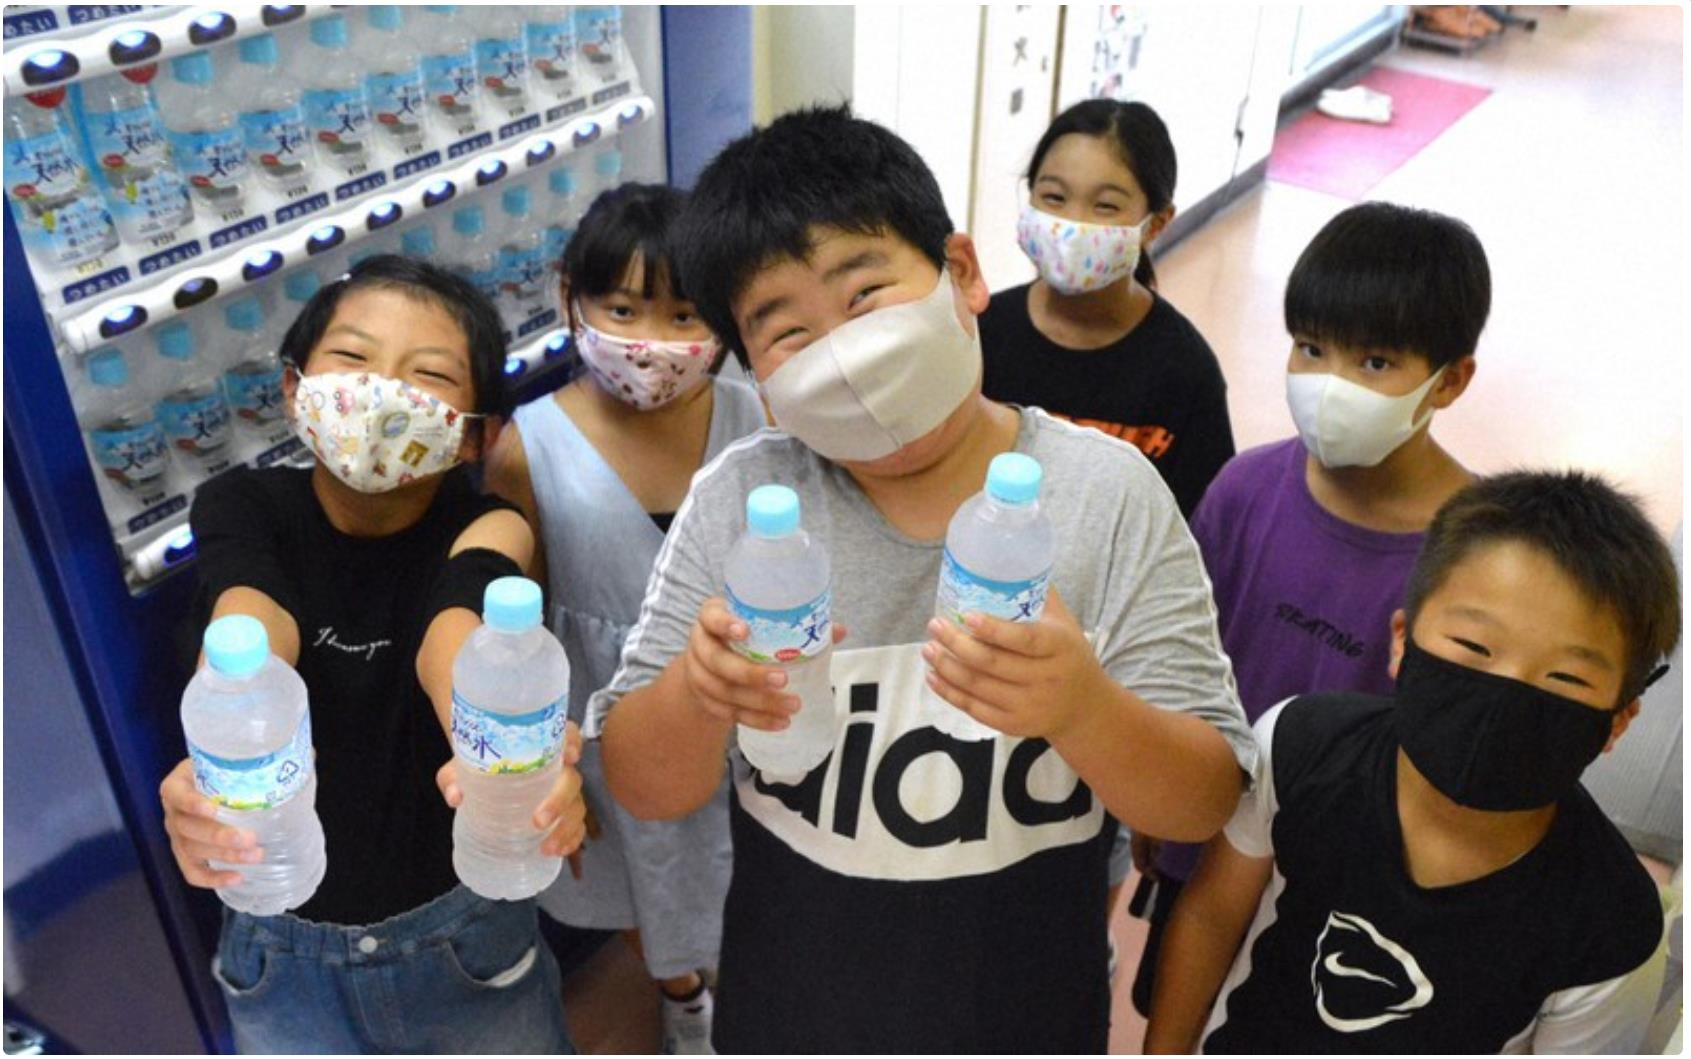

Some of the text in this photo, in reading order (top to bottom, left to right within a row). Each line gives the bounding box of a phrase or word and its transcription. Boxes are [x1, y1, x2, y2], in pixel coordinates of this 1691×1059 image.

[279, 195, 327, 221] つめたい
[212, 219, 264, 247] つめたい
[143, 244, 199, 272] つめたい
[67, 270, 127, 297] つめたい
